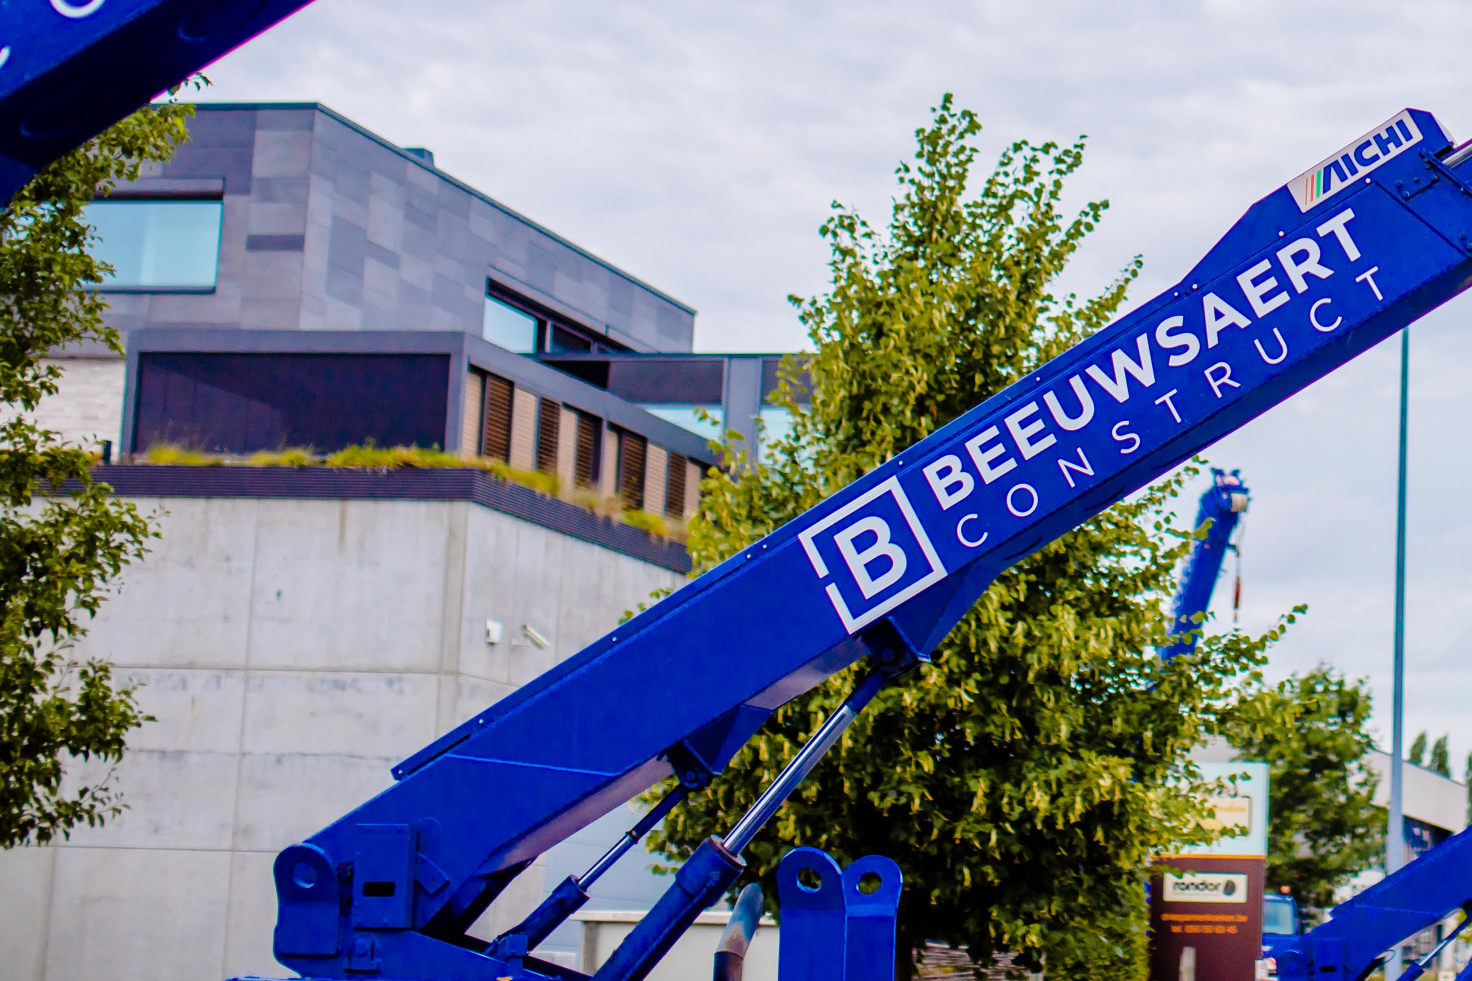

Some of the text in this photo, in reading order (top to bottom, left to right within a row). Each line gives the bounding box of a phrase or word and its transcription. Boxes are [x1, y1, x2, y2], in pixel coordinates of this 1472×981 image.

[1322, 118, 1414, 195] AICHI
[922, 208, 1362, 511] BEEUWSAERT
[956, 265, 1383, 548] CONSTRUCT
